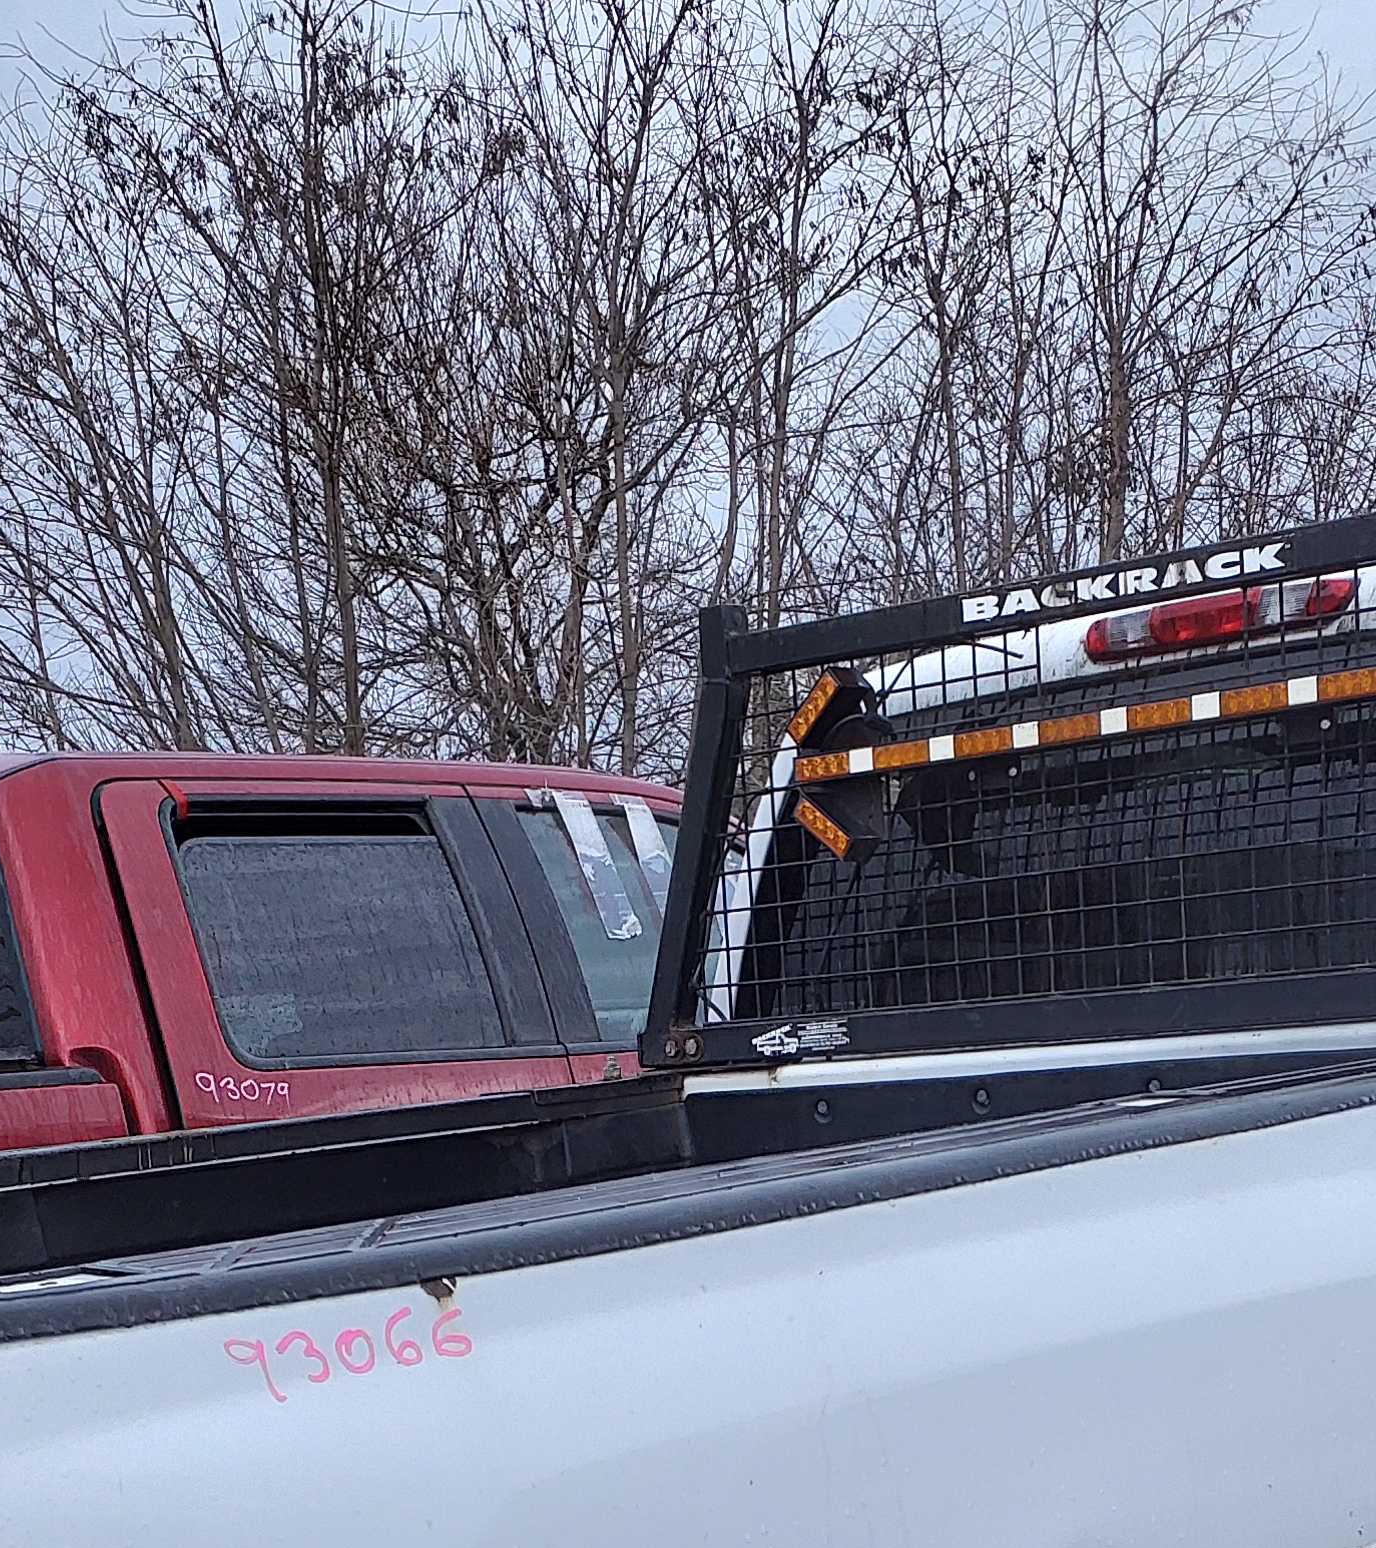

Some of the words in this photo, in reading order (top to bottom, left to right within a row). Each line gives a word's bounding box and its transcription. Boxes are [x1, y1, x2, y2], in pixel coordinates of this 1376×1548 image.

[962, 542, 1288, 623] BACKRACK
[195, 1072, 290, 1111] 93079
[224, 1306, 472, 1402] 93066
